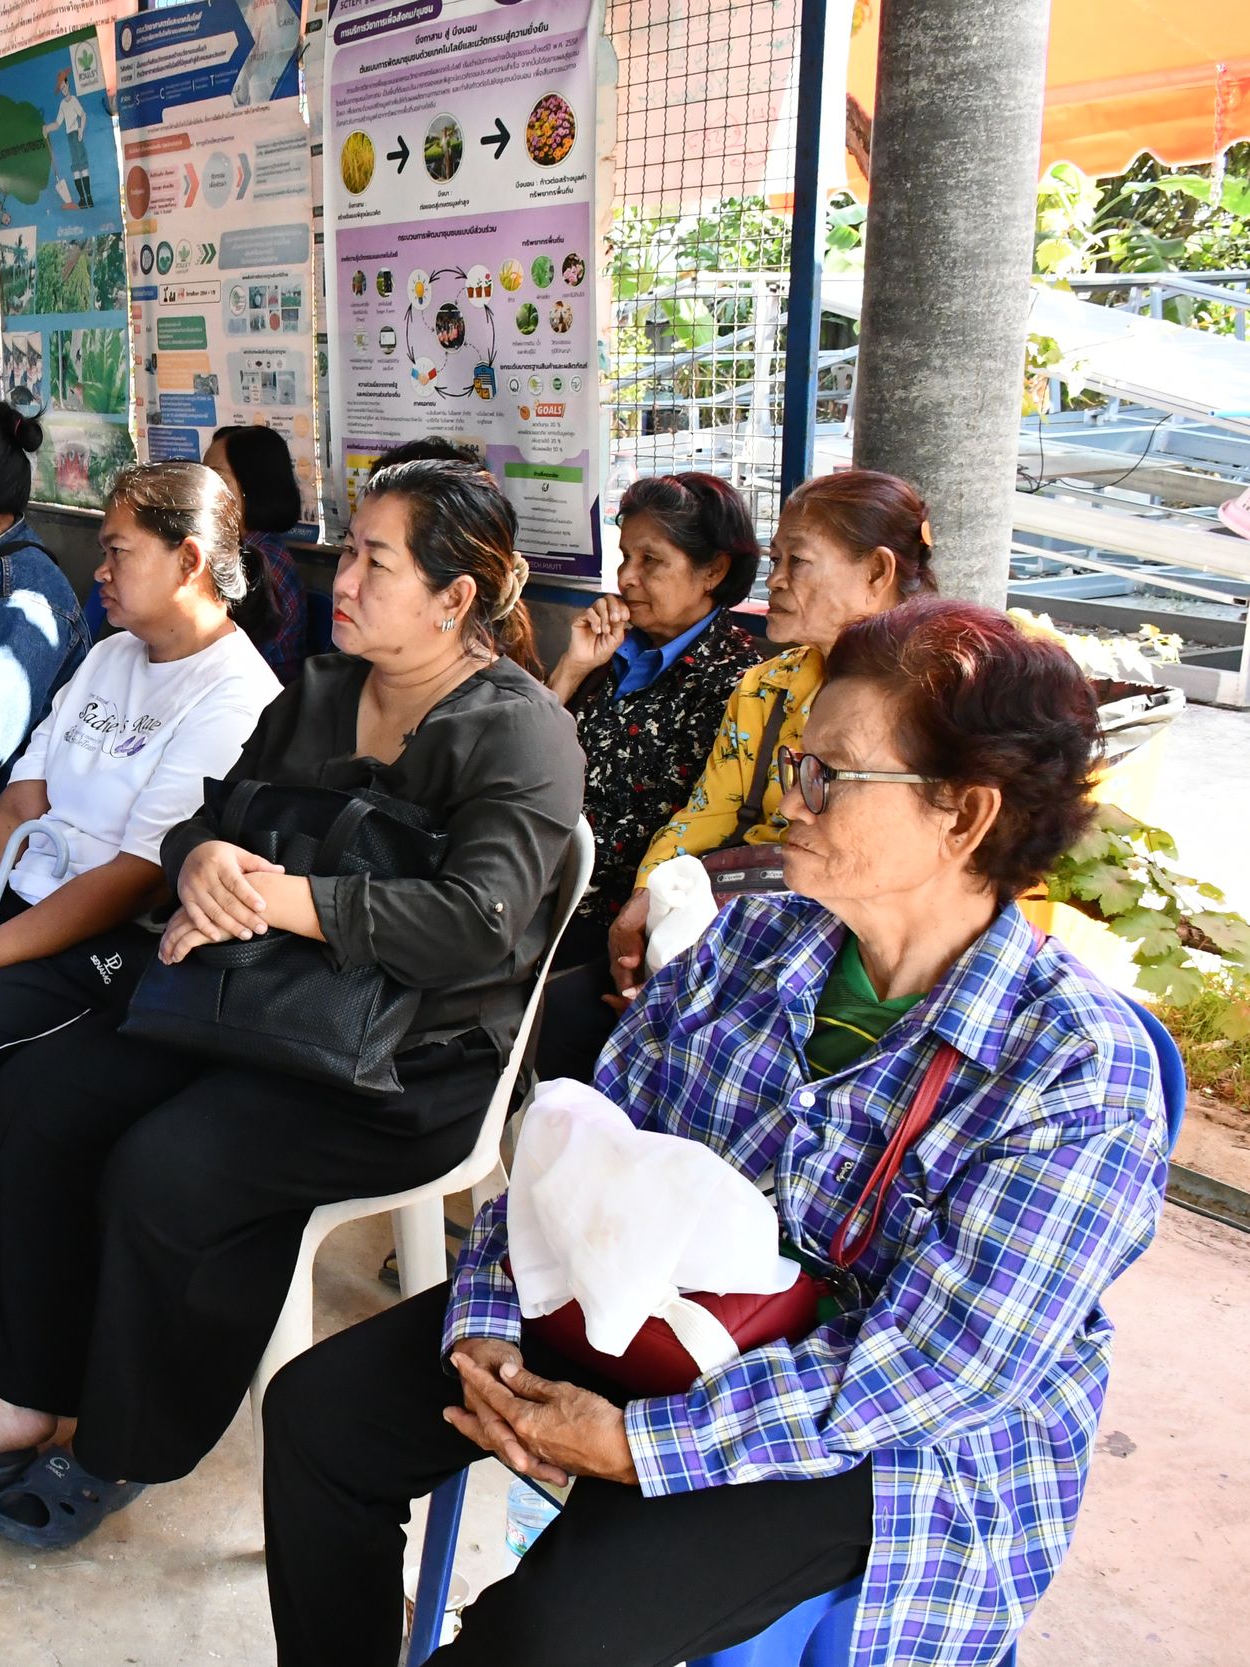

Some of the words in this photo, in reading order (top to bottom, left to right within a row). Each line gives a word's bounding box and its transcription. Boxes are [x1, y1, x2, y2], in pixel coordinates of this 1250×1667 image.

[415, 31, 443, 45] บึงกาสาม
[451, 23, 478, 36] บึงบอน
[537, 405, 562, 415] GOALS
[79, 702, 129, 734] Sadie's
[132, 714, 161, 734] Rae
